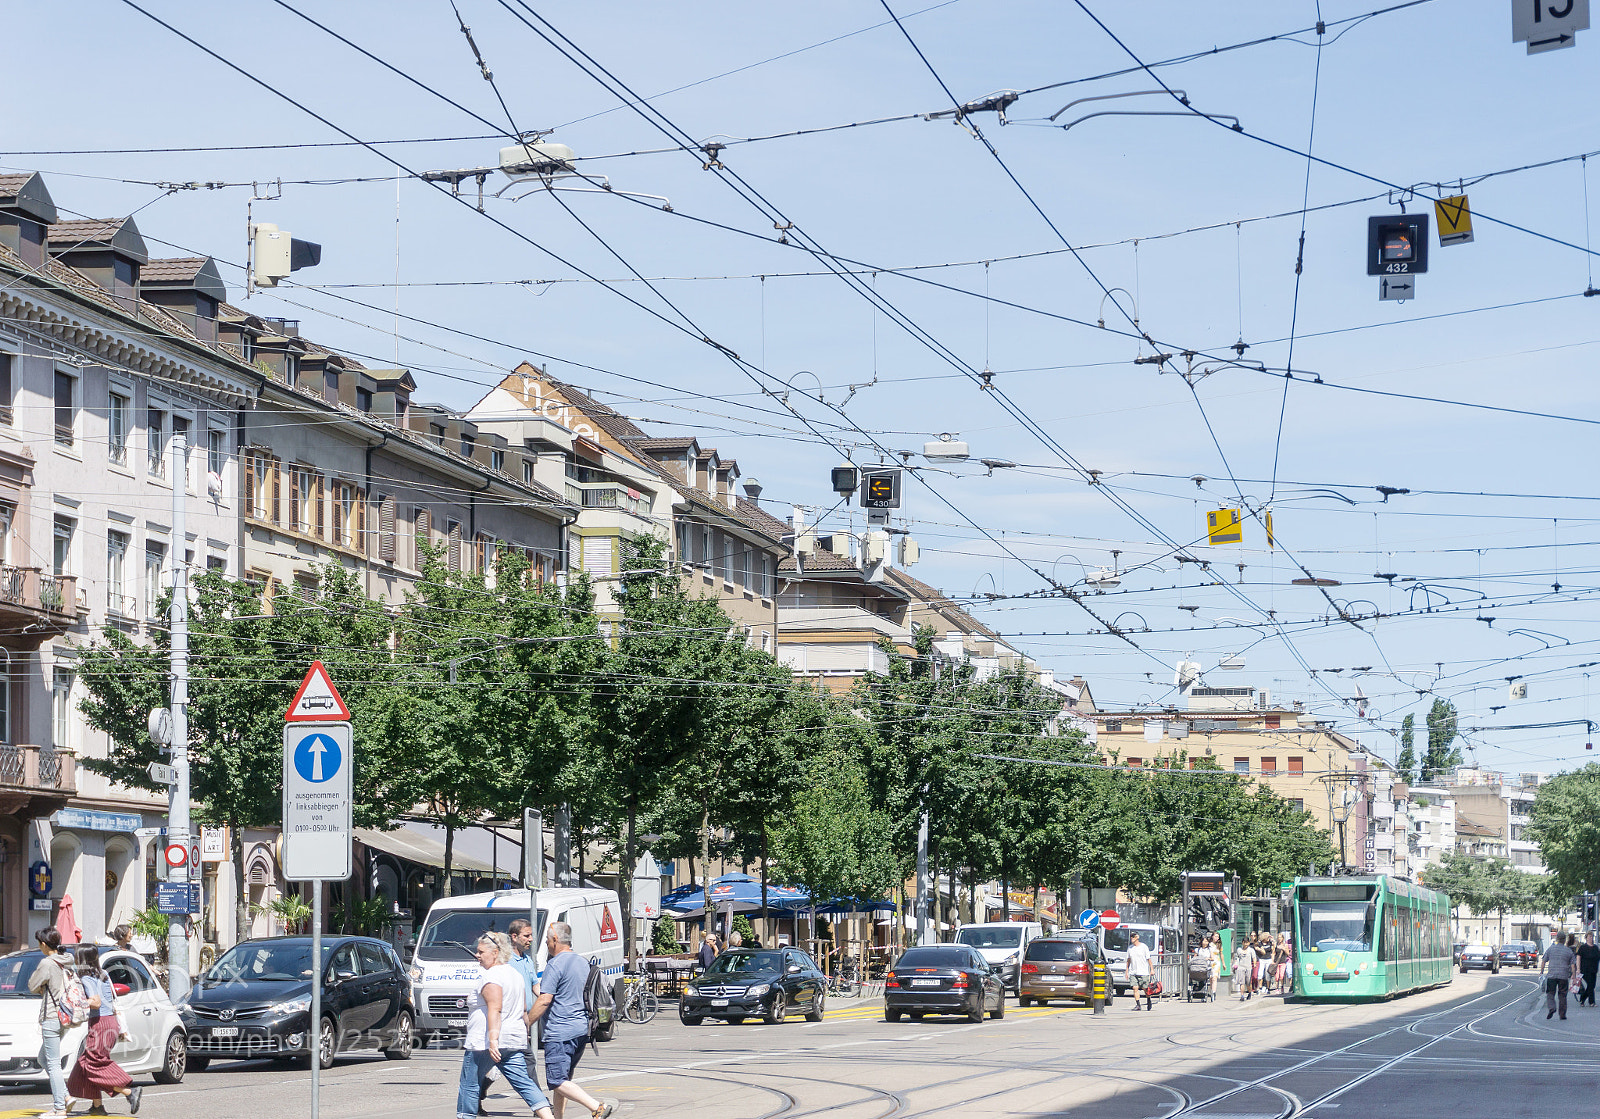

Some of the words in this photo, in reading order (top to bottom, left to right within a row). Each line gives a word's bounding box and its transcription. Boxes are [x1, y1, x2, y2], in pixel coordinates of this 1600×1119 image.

[1385, 263, 1408, 273] 432
[1511, 685, 1526, 696] 45
[296, 802, 339, 811] linksabbiegen
[328, 824, 340, 832] Uhr
